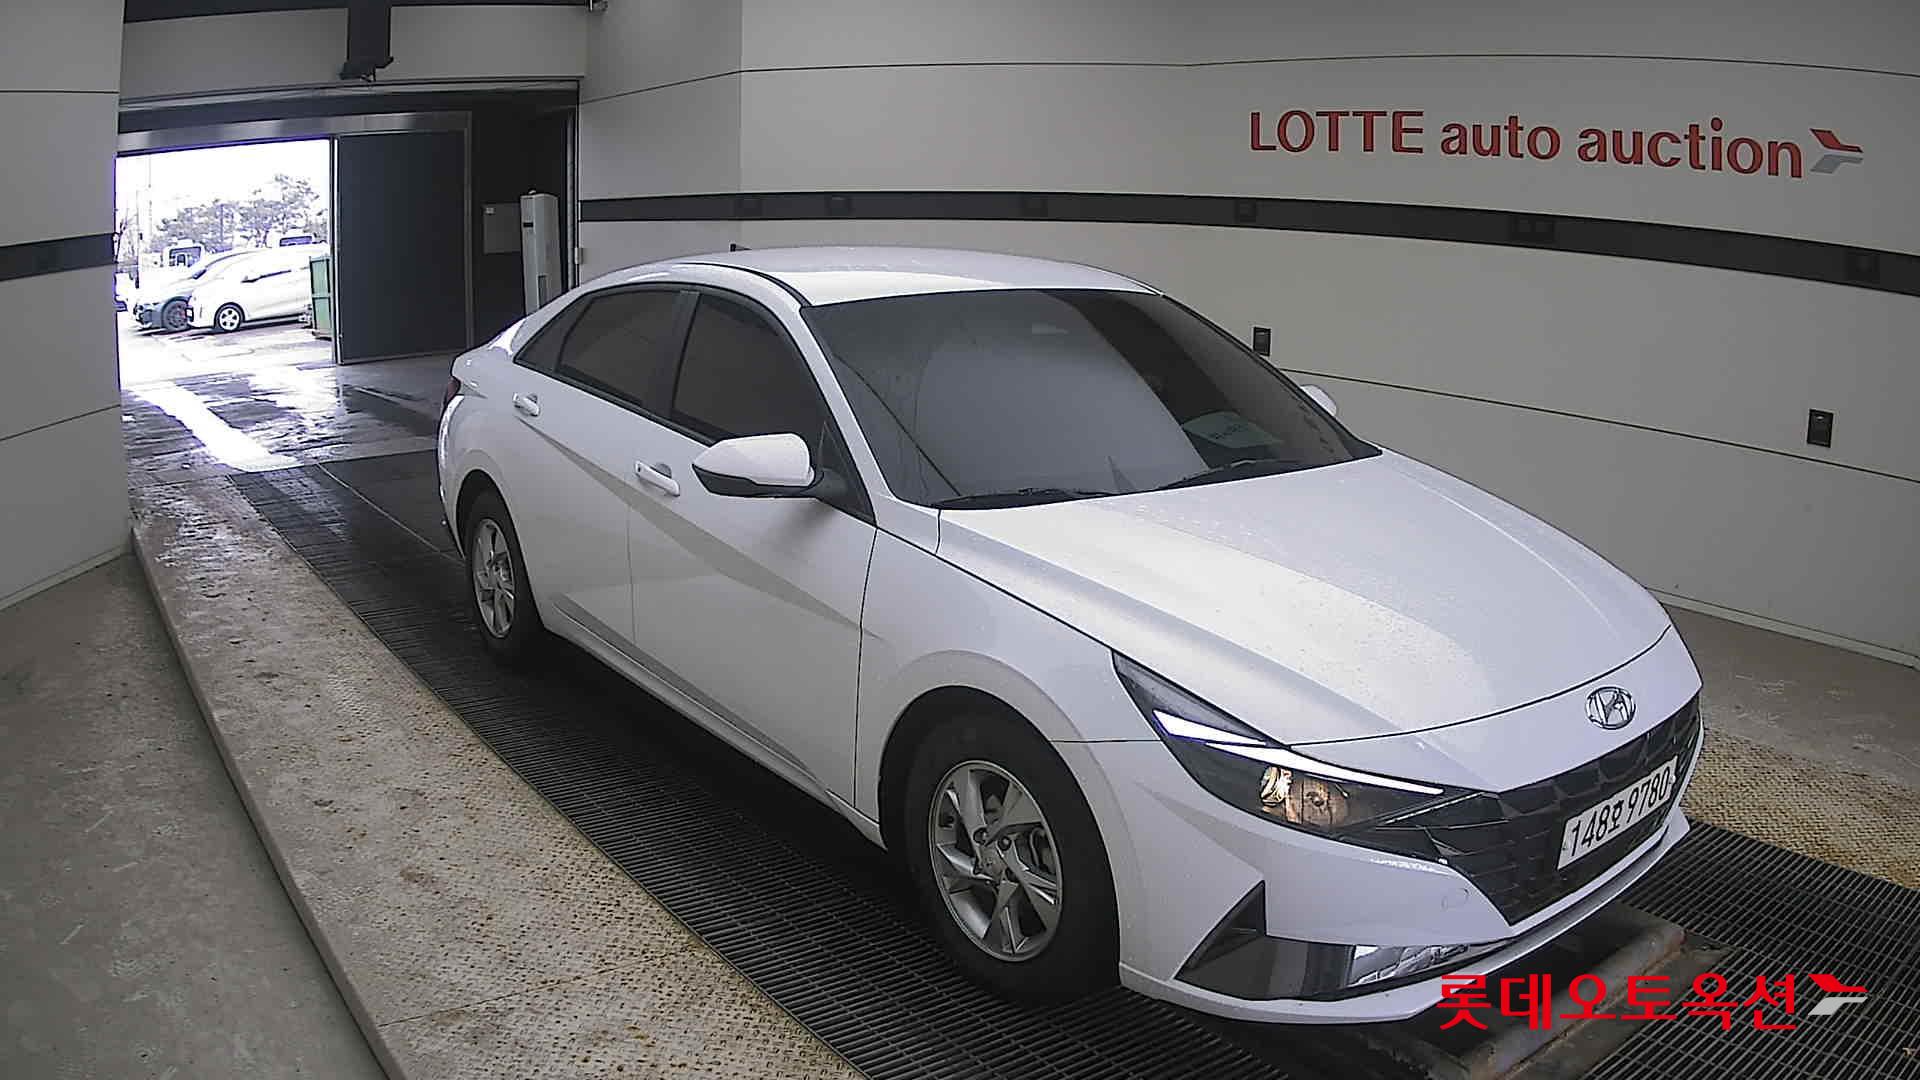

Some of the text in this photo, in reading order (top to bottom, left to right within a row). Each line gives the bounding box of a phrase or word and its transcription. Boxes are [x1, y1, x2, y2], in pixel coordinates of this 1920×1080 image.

[1250, 111, 1803, 179] LOTTE auto auction
